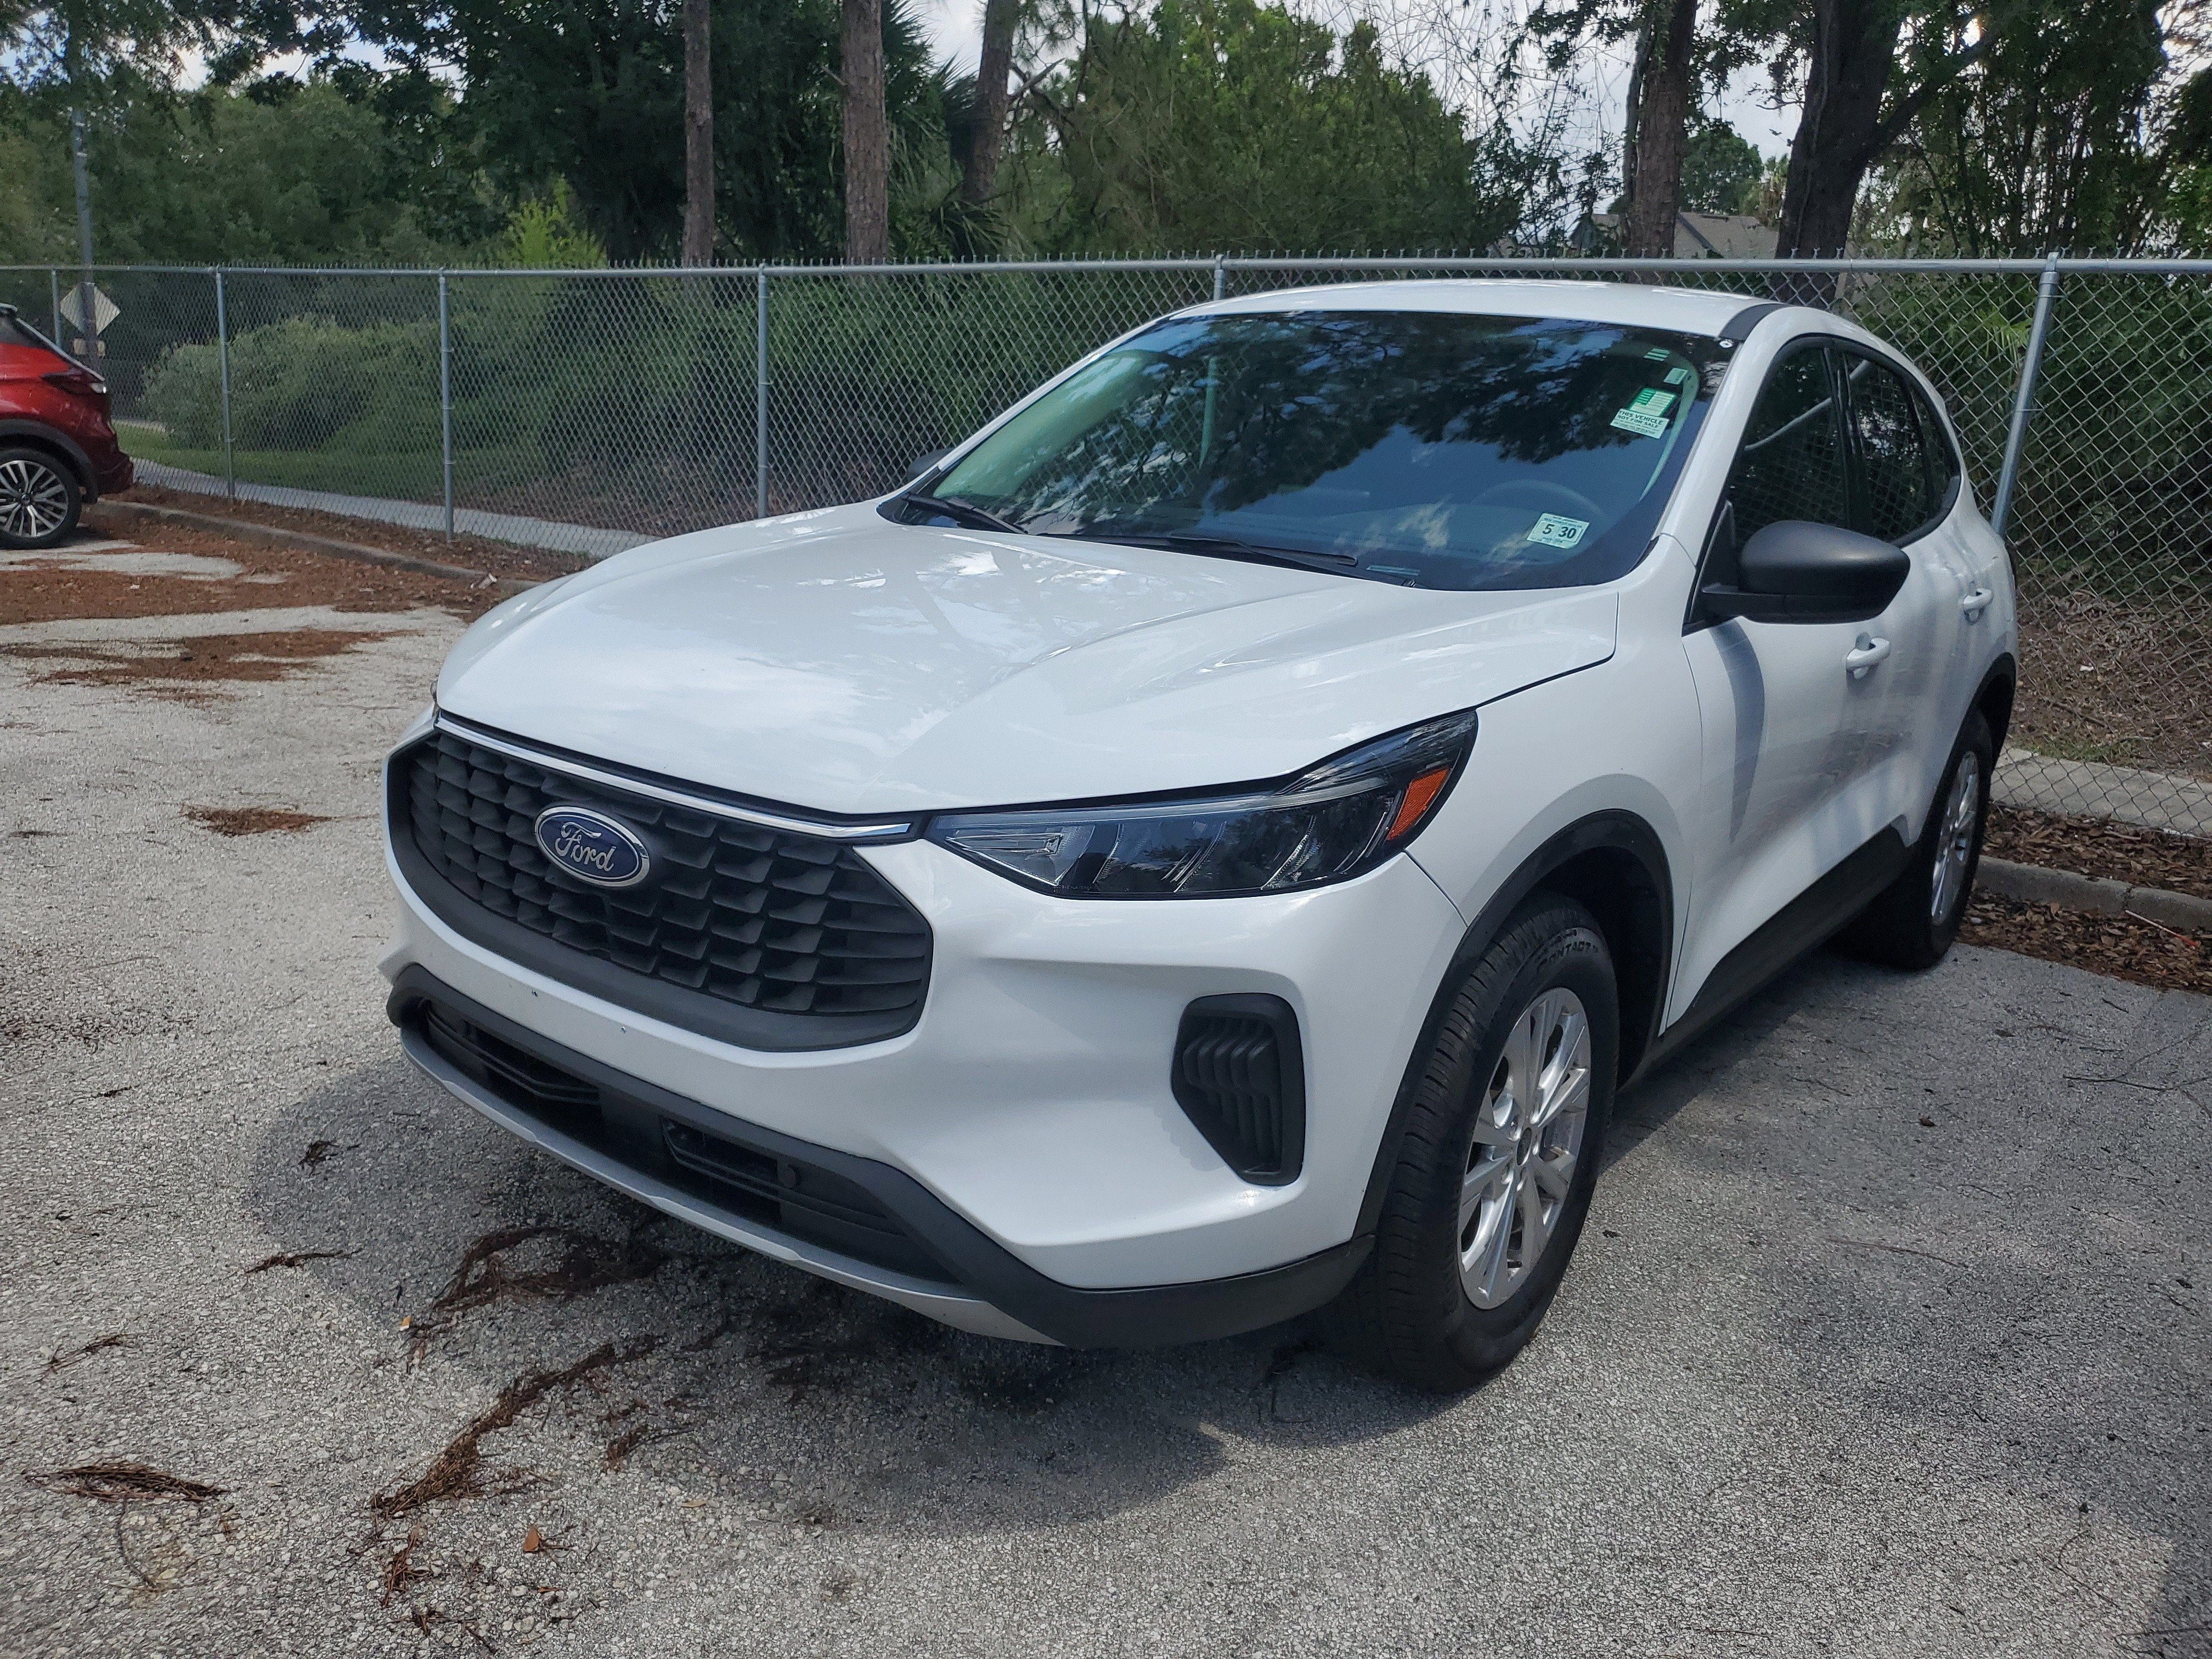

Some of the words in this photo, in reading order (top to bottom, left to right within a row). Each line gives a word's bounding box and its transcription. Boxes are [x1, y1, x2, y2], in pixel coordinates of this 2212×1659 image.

[1635, 414, 1663, 425] VEHICLE
[1542, 523, 1555, 535] 5
[1558, 526, 1577, 539] 30
[555, 822, 617, 872] Ford
